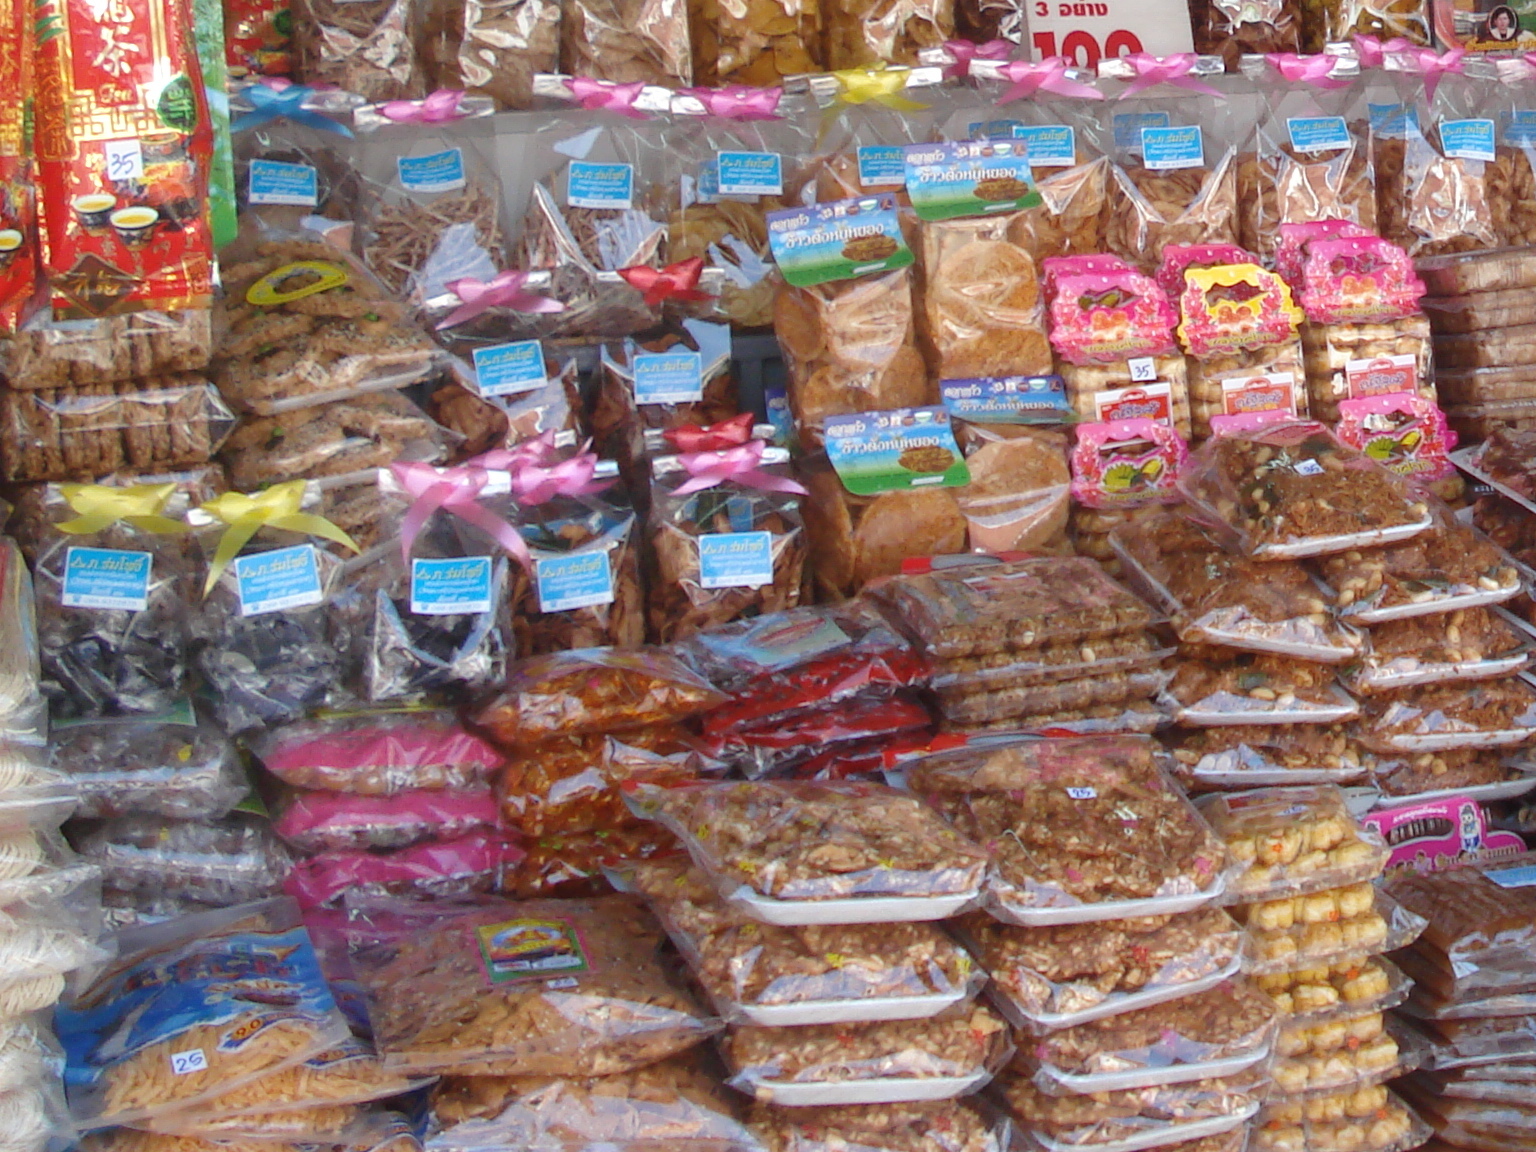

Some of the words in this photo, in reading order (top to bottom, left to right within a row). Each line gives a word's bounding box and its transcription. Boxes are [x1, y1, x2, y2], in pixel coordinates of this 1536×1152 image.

[1035, 1, 1049, 17] 3
[112, 151, 139, 176] 35
[1133, 365, 1151, 379] 35
